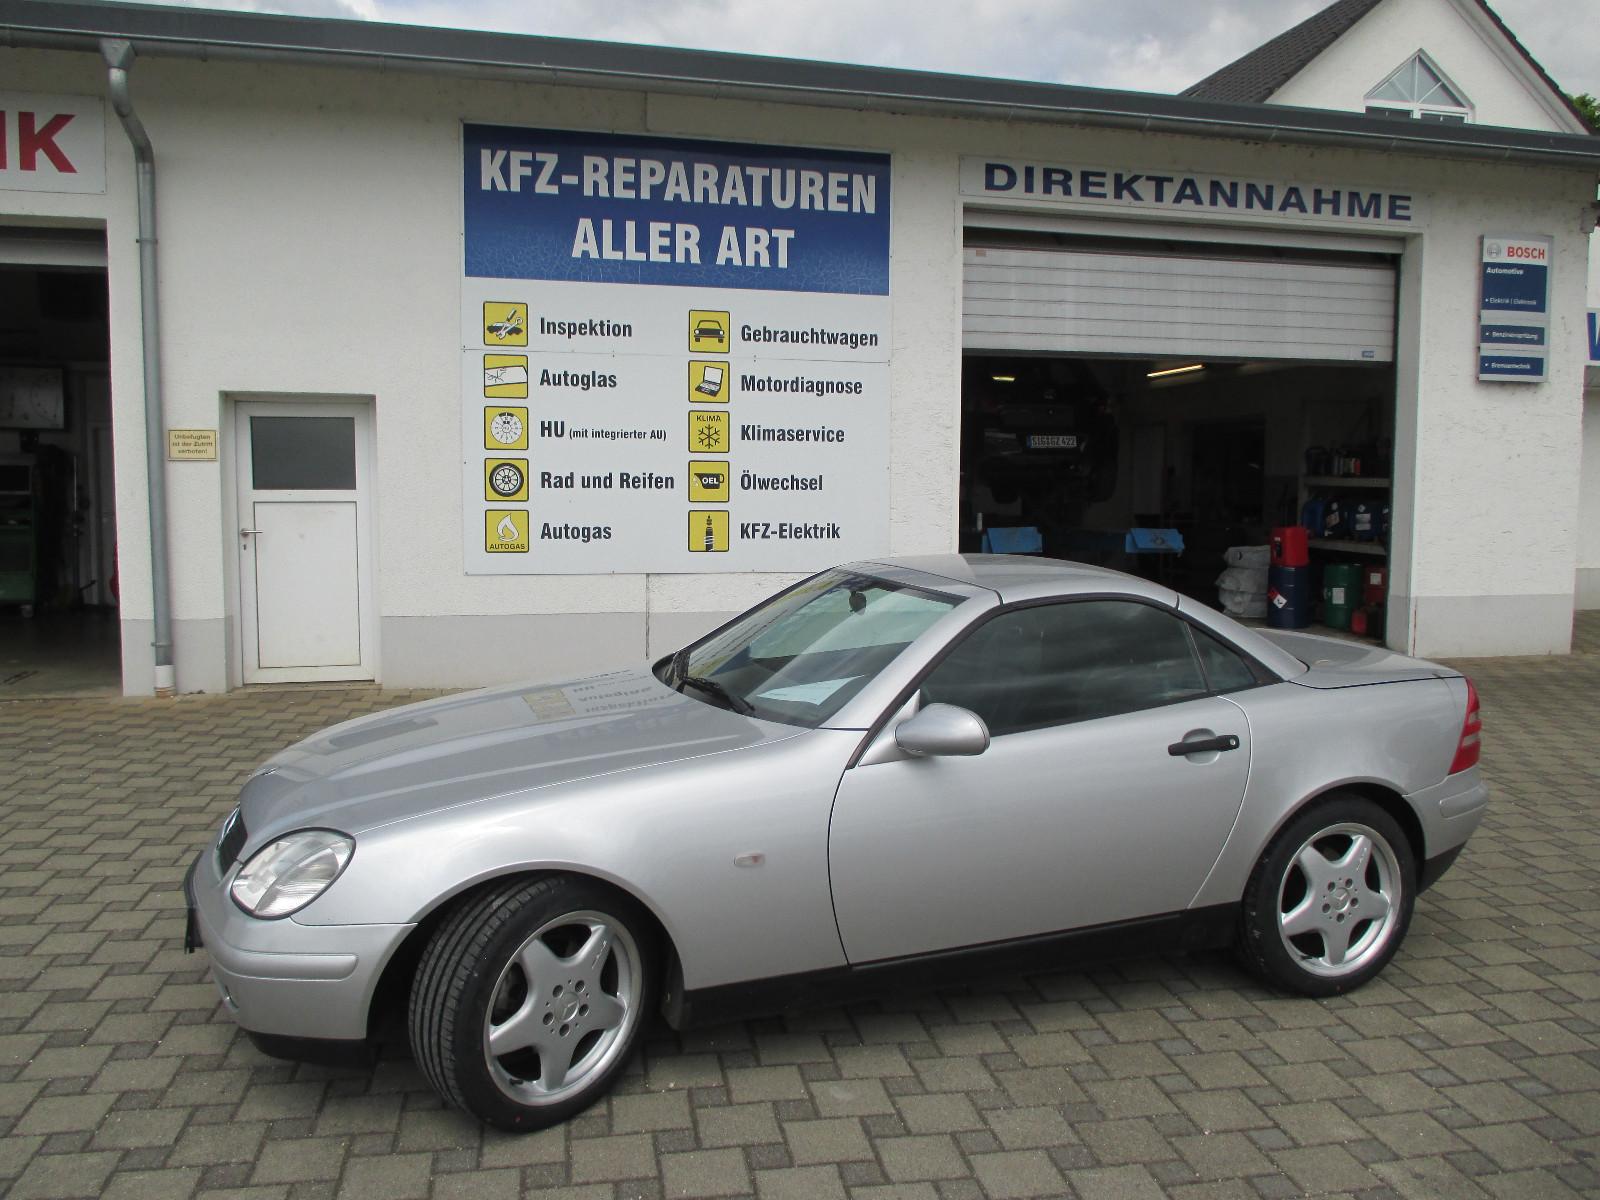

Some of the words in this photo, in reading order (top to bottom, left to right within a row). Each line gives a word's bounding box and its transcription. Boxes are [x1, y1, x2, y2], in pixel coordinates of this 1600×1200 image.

[480, 148, 876, 215] KFZ-REPARATUREN
[984, 162, 1412, 222] DIREKTANNAHME
[571, 217, 701, 265] ALLER
[715, 226, 795, 269] ART
[1507, 246, 1545, 260] BOSCH
[1486, 267, 1524, 275] Automotive
[540, 316, 633, 341] Inspektion
[740, 325, 879, 349] Gebrauchtwagen
[540, 370, 618, 390] Autoglas
[740, 375, 863, 396] Motordiagnose
[540, 420, 565, 438] HU
[569, 429, 588, 440] (mit
[591, 429, 647, 441] integrierter
[650, 430, 667, 441] AU)
[740, 425, 845, 444] Klimaservice
[540, 471, 575, 489] Rad
[581, 472, 613, 489] und
[619, 472, 675, 489] Reifen
[702, 477, 719, 485] OEL
[740, 469, 823, 491] Ölwechsel
[540, 522, 612, 543] Autogas
[740, 522, 841, 541] KFZ-Elektrik
[489, 543, 526, 551] AUTOGAS
